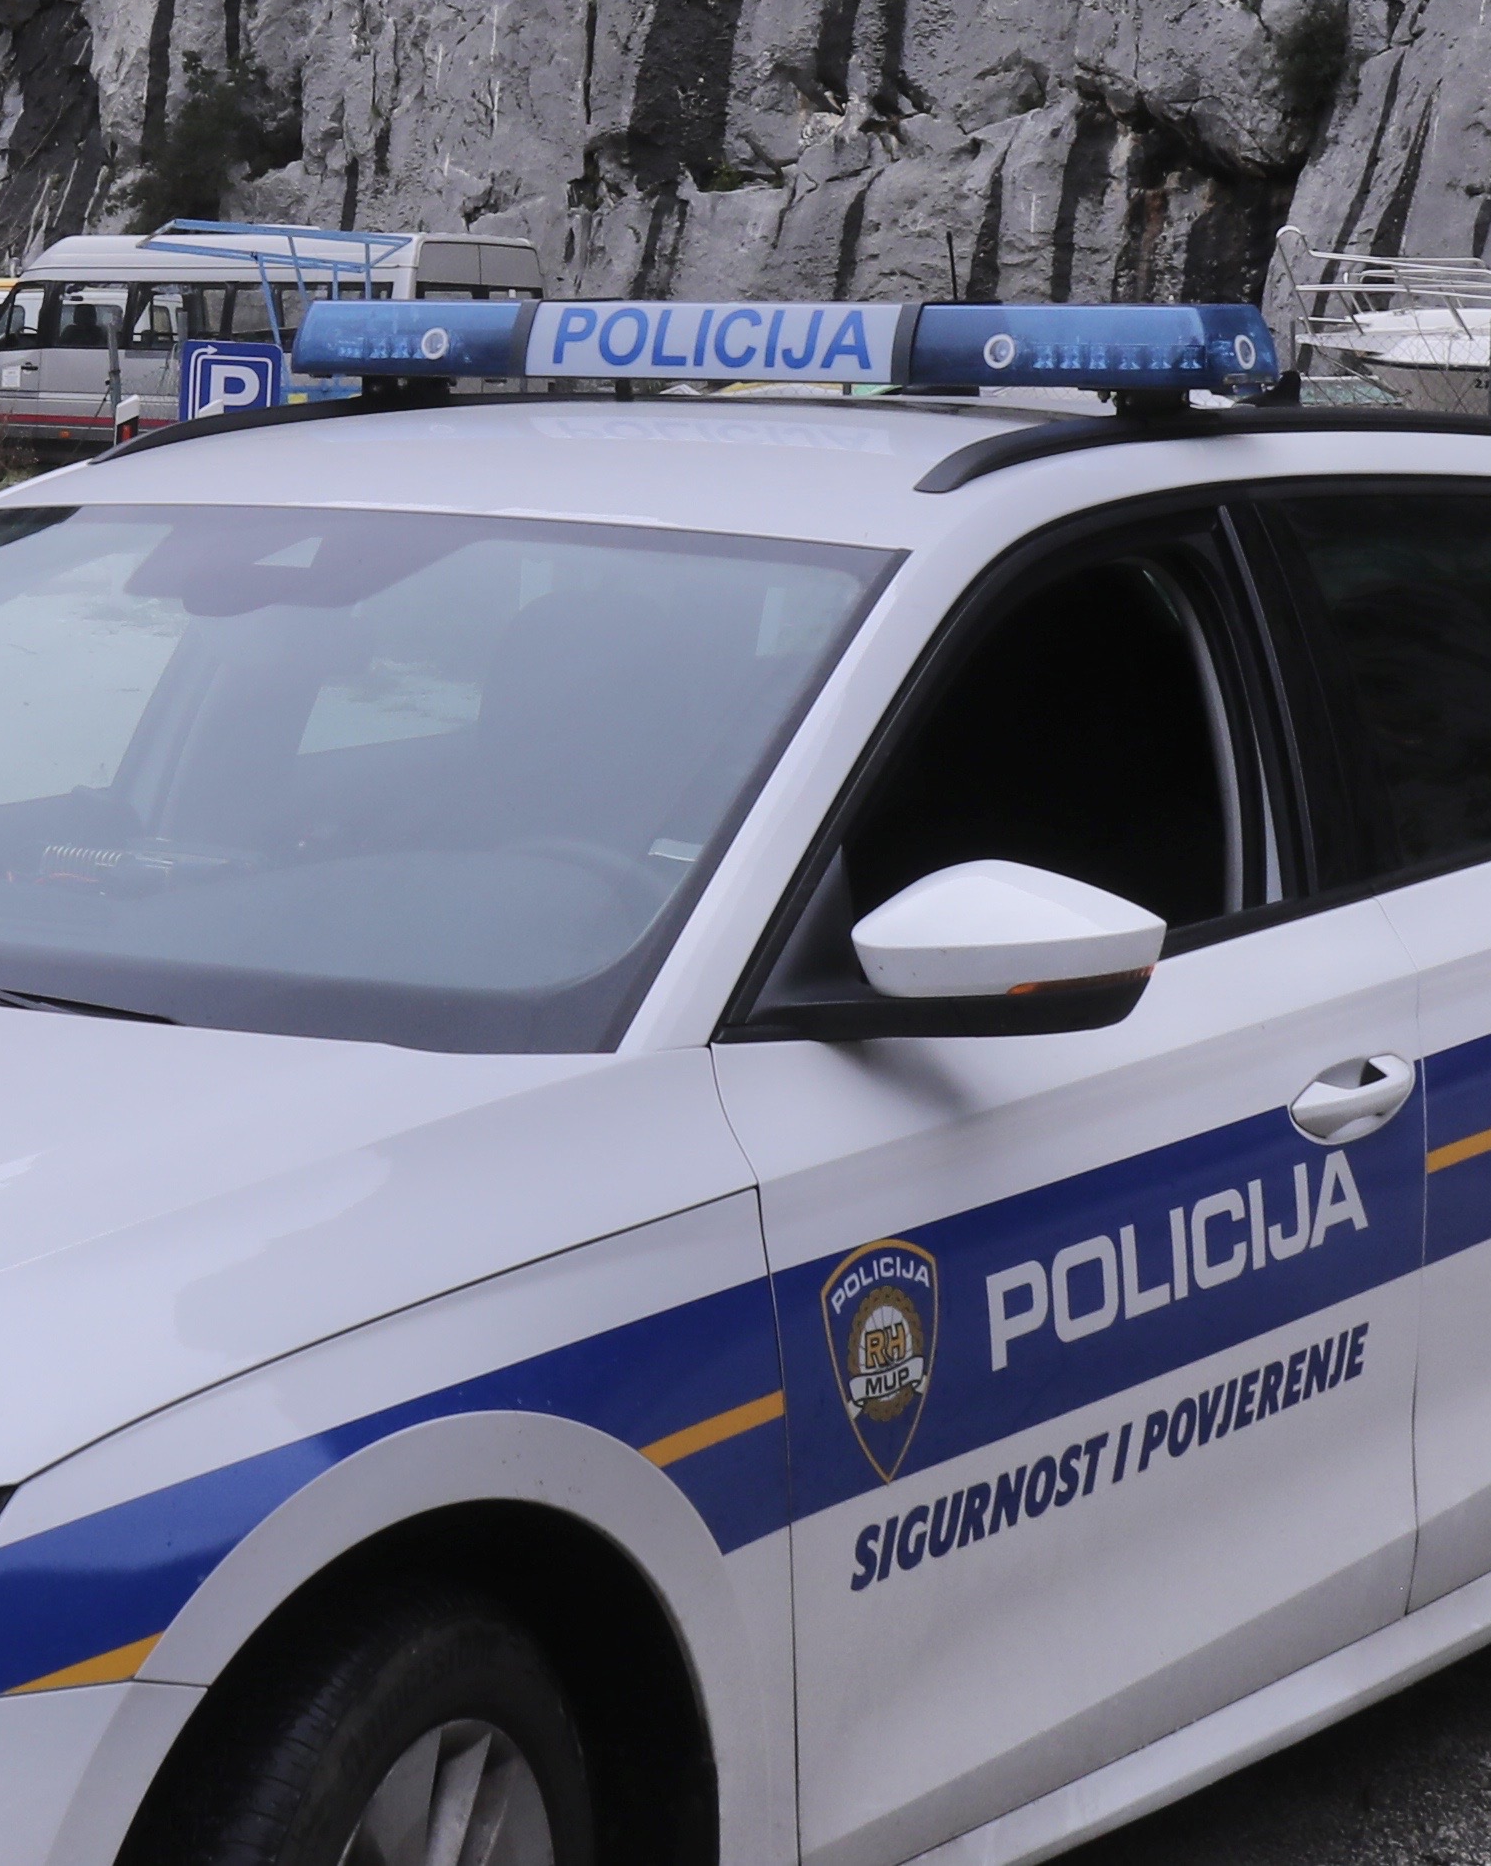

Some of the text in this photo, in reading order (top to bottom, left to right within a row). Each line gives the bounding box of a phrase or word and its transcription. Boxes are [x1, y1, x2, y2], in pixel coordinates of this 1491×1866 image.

[552, 308, 871, 369] POLICIJA
[209, 364, 260, 406] P
[831, 1256, 930, 1315] POLICIJA
[985, 1150, 1369, 1372] POLICIJA
[864, 1322, 907, 1370] RH
[865, 1367, 910, 1397] MUP
[850, 1321, 1370, 1592] SIGURNOST I POVJERENJE
